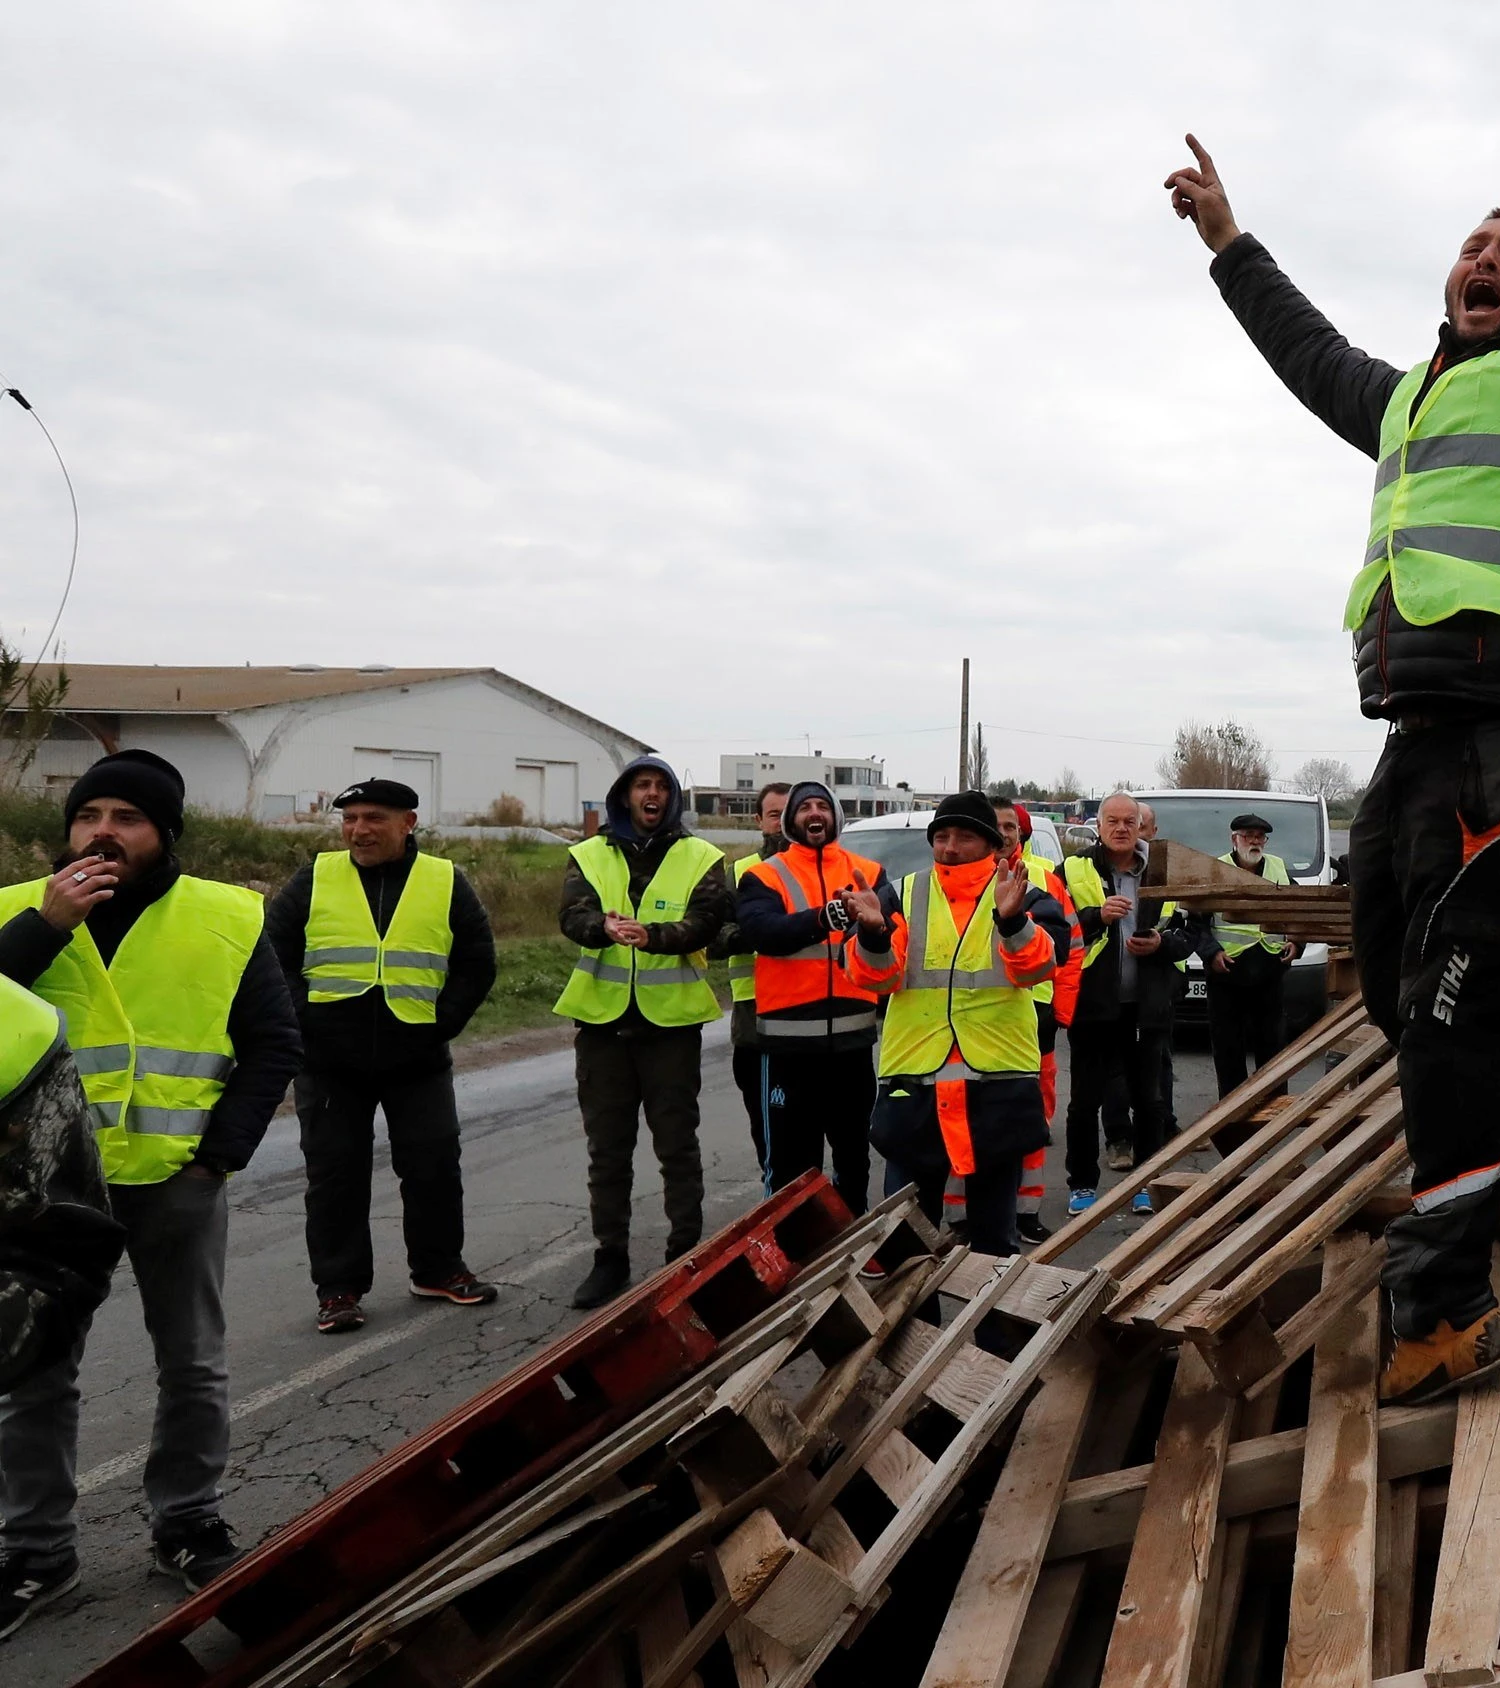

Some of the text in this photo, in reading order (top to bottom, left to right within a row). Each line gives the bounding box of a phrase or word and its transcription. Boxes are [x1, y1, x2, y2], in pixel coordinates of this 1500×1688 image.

[1432, 952, 1471, 1026] STIHL
[172, 1548, 196, 1569] N
[13, 1579, 44, 1600] N
